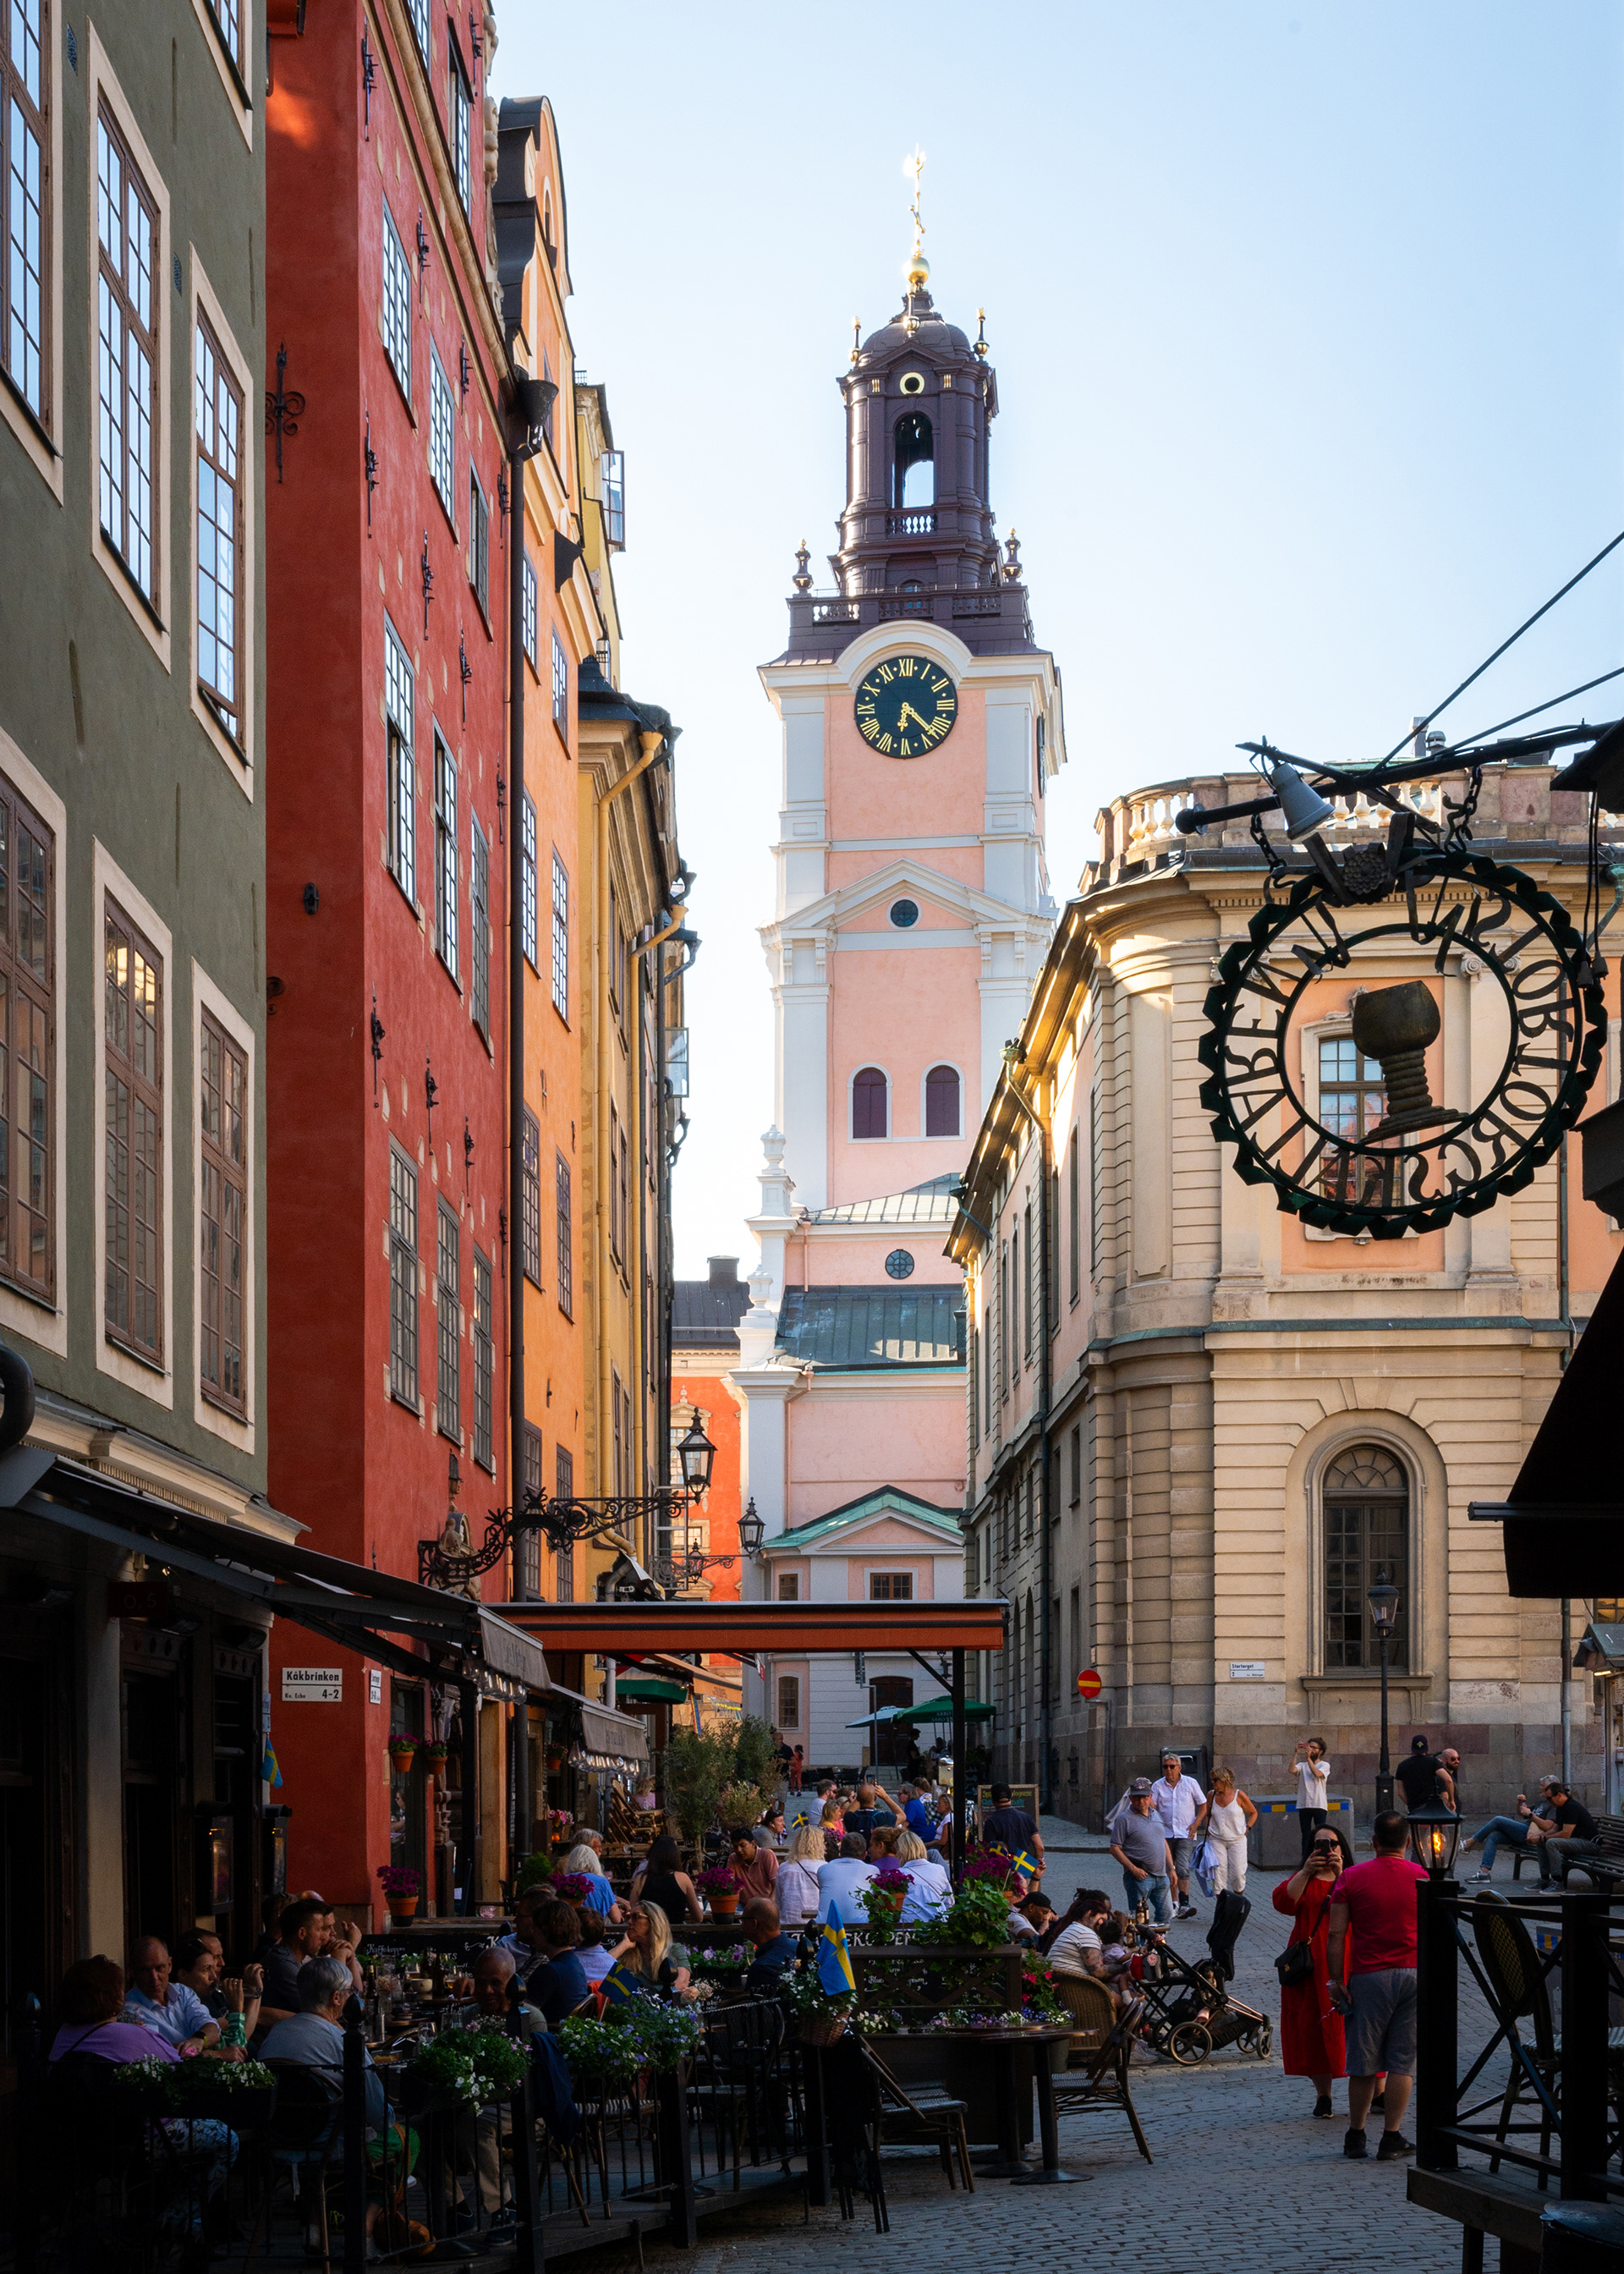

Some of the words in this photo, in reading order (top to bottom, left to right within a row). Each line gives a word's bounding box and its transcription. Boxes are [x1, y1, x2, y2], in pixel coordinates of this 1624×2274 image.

[878, 664, 894, 684] XI
[898, 658, 914, 677] XII
[920, 663, 931, 679] I
[862, 682, 881, 696] X
[931, 678, 949, 693] II
[857, 703, 875, 715] IX
[936, 699, 954, 711] III
[860, 718, 880, 740] VIII
[876, 733, 892, 752] VII
[901, 738, 911, 755] VI
[921, 734, 933, 750] V
[287, 1671, 339, 1681] Kåkbrinken
[322, 1689, 338, 1699] 4-2
